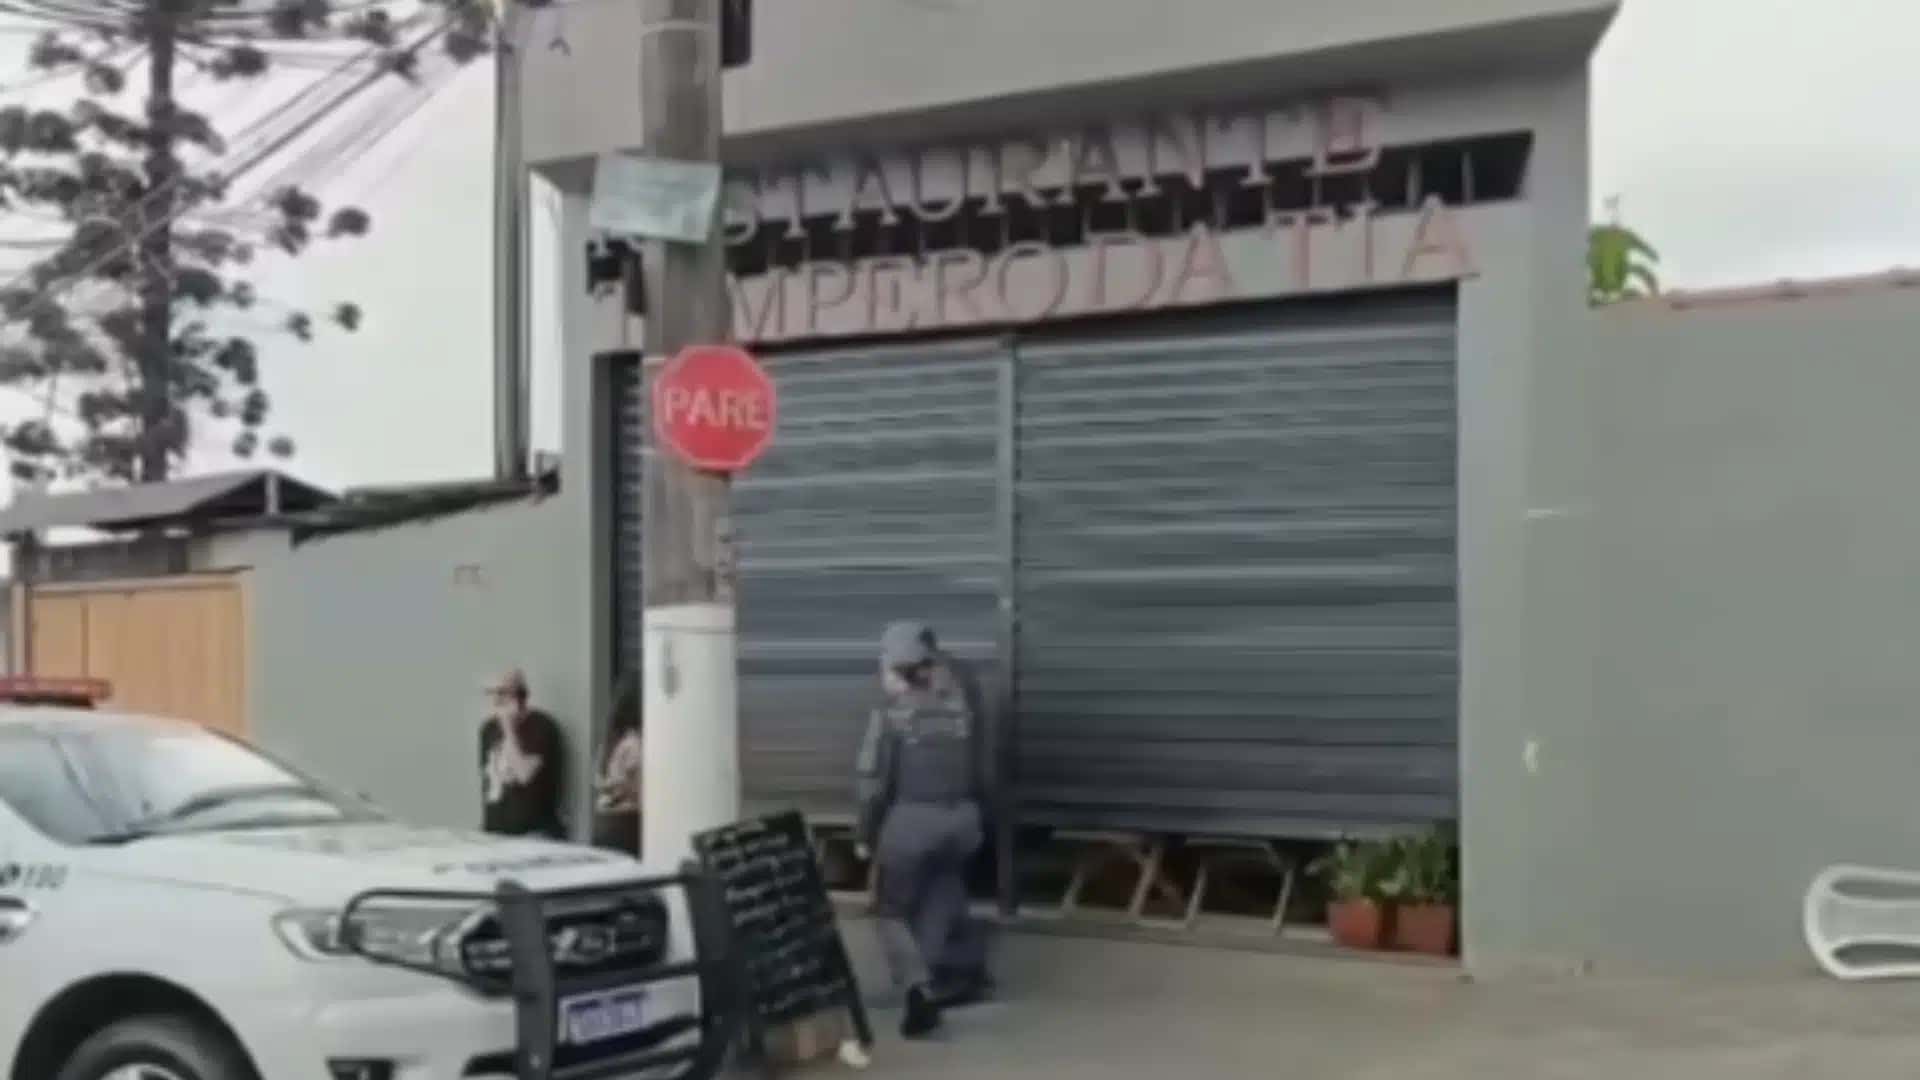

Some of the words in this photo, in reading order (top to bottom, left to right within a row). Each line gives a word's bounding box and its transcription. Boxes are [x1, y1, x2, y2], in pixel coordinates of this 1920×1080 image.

[588, 90, 1386, 257] STAURANTE
[1264, 194, 1481, 290] TIA
[663, 384, 770, 432] PARE
